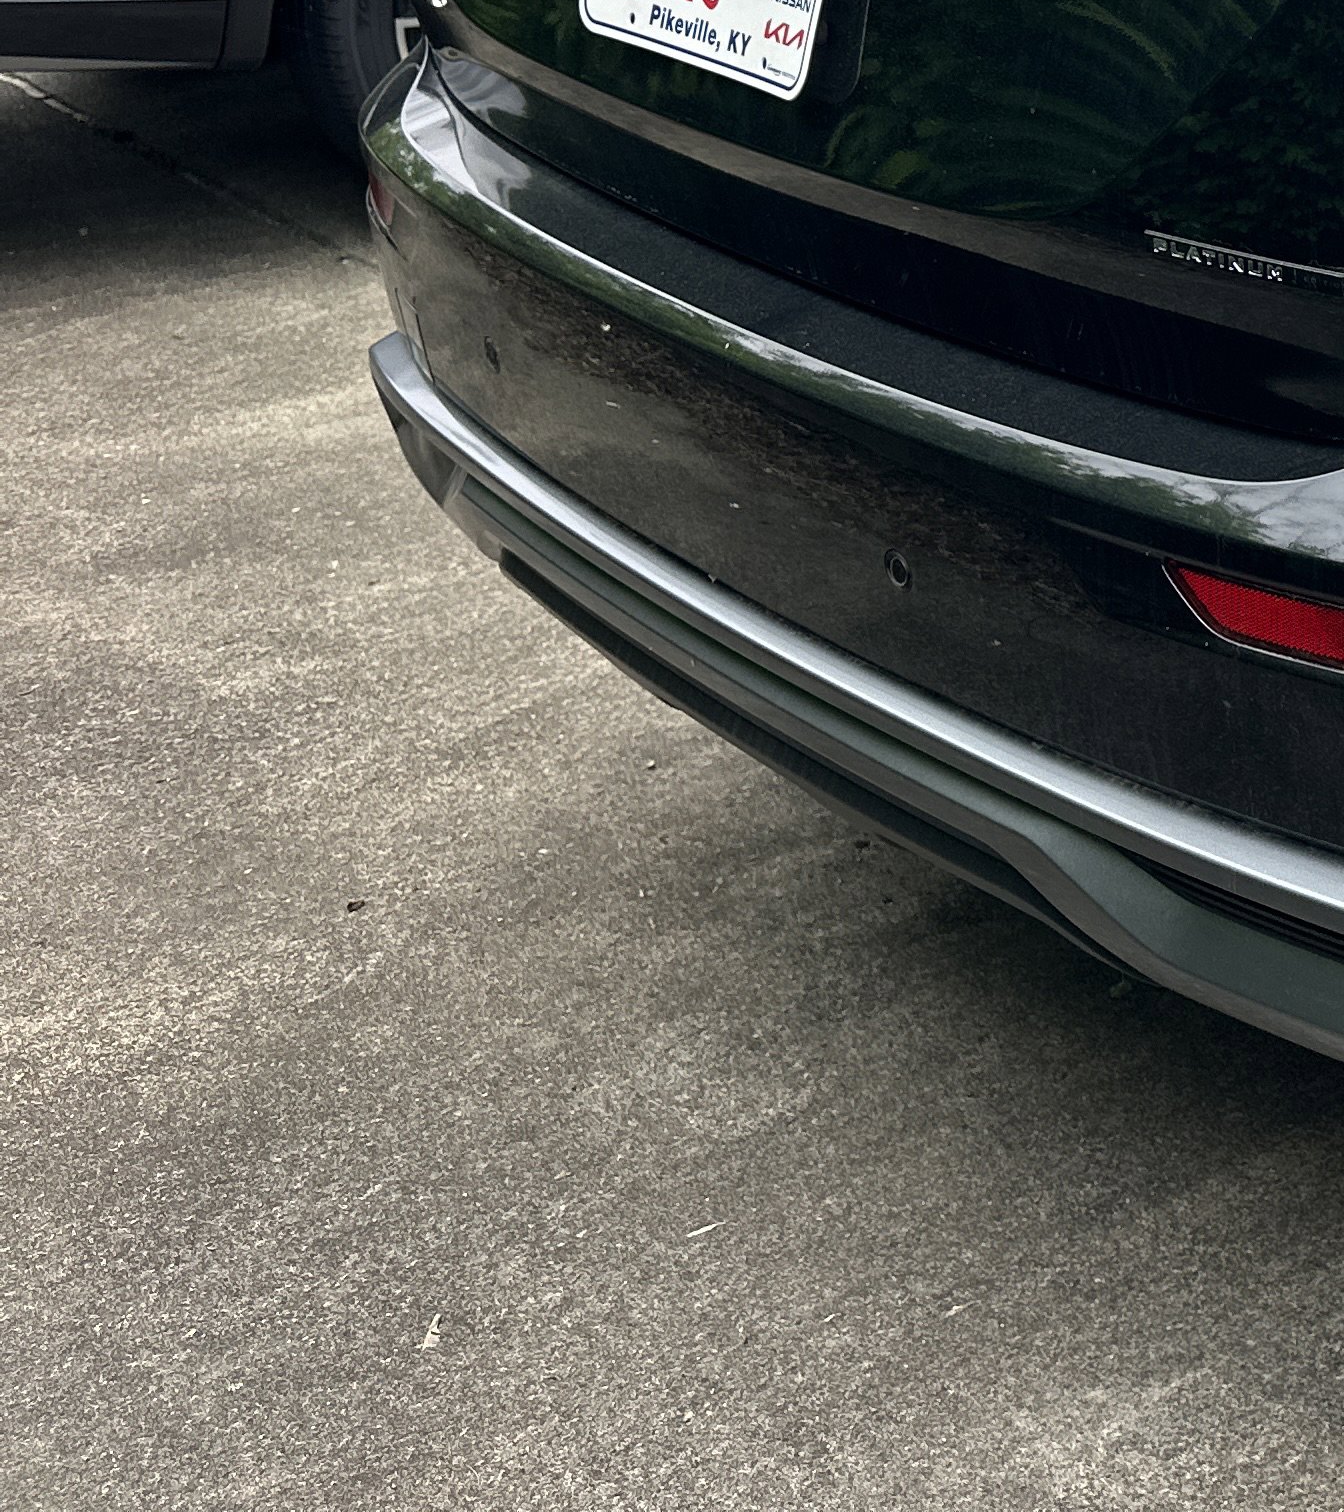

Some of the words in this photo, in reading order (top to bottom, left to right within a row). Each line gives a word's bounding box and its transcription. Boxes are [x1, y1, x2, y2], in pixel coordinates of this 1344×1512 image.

[649, 4, 721, 53] Pikeville,
[727, 29, 752, 57] KY
[1152, 237, 1283, 282] PLATINUM
